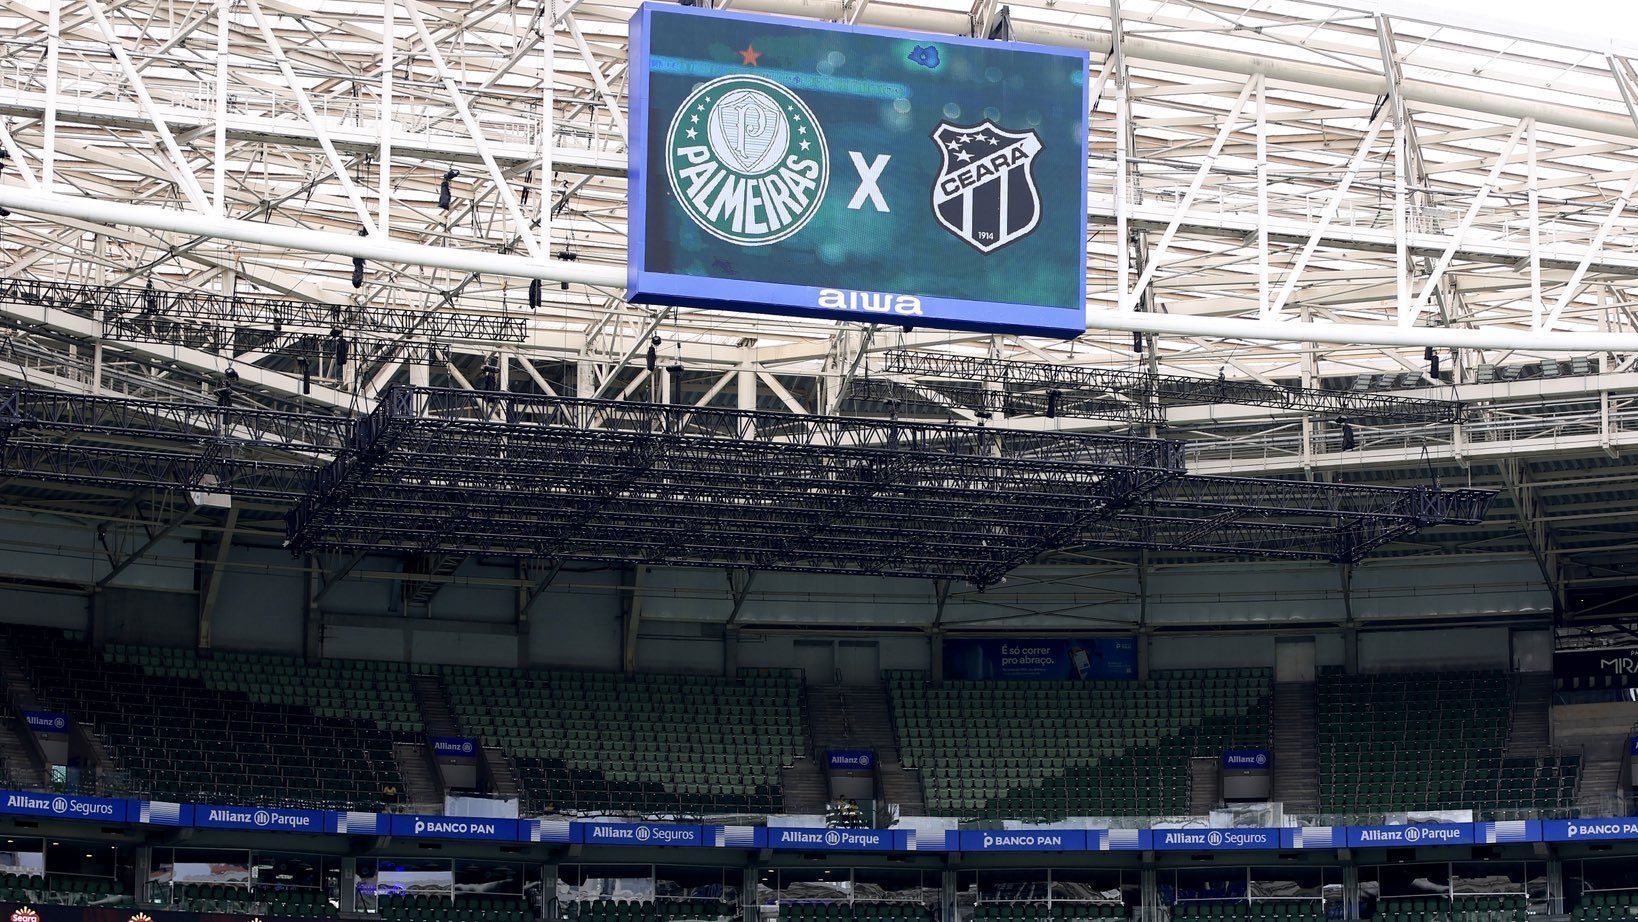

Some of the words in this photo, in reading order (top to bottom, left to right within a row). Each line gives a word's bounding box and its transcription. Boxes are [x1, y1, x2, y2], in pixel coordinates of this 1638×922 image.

[940, 142, 1030, 197] CEARÁ
[847, 150, 891, 213] X
[676, 145, 820, 235] PALMEIRAS
[977, 231, 995, 240] 1914
[1001, 643, 1008, 655] É
[1009, 645, 1021, 655] só
[1021, 647, 1051, 655] correr
[1001, 657, 1018, 666] pro
[1019, 656, 1055, 667] abraço.
[25, 716, 53, 726] Allianz
[434, 741, 462, 751] Allianz
[831, 755, 858, 765] Allianz
[1227, 754, 1255, 763] Allianz
[8, 795, 50, 811] Allianz
[69, 799, 113, 816] Seguros
[208, 809, 252, 823] Allianz
[271, 813, 310, 828] Parque
[426, 822, 467, 833] BANCO
[470, 823, 495, 834] PAN
[593, 826, 633, 839] Allianz
[652, 827, 695, 842] Seguros
[1579, 824, 1620, 835] BANCO
[781, 831, 823, 845] Allianz
[841, 832, 880, 847] Parque
[1165, 832, 1206, 844] Allianz
[1224, 832, 1267, 847] Seguros
[1360, 829, 1403, 842] Allianz
[1421, 827, 1461, 842] Parque
[995, 836, 1034, 846] BANCO
[1037, 836, 1061, 846] PAN
